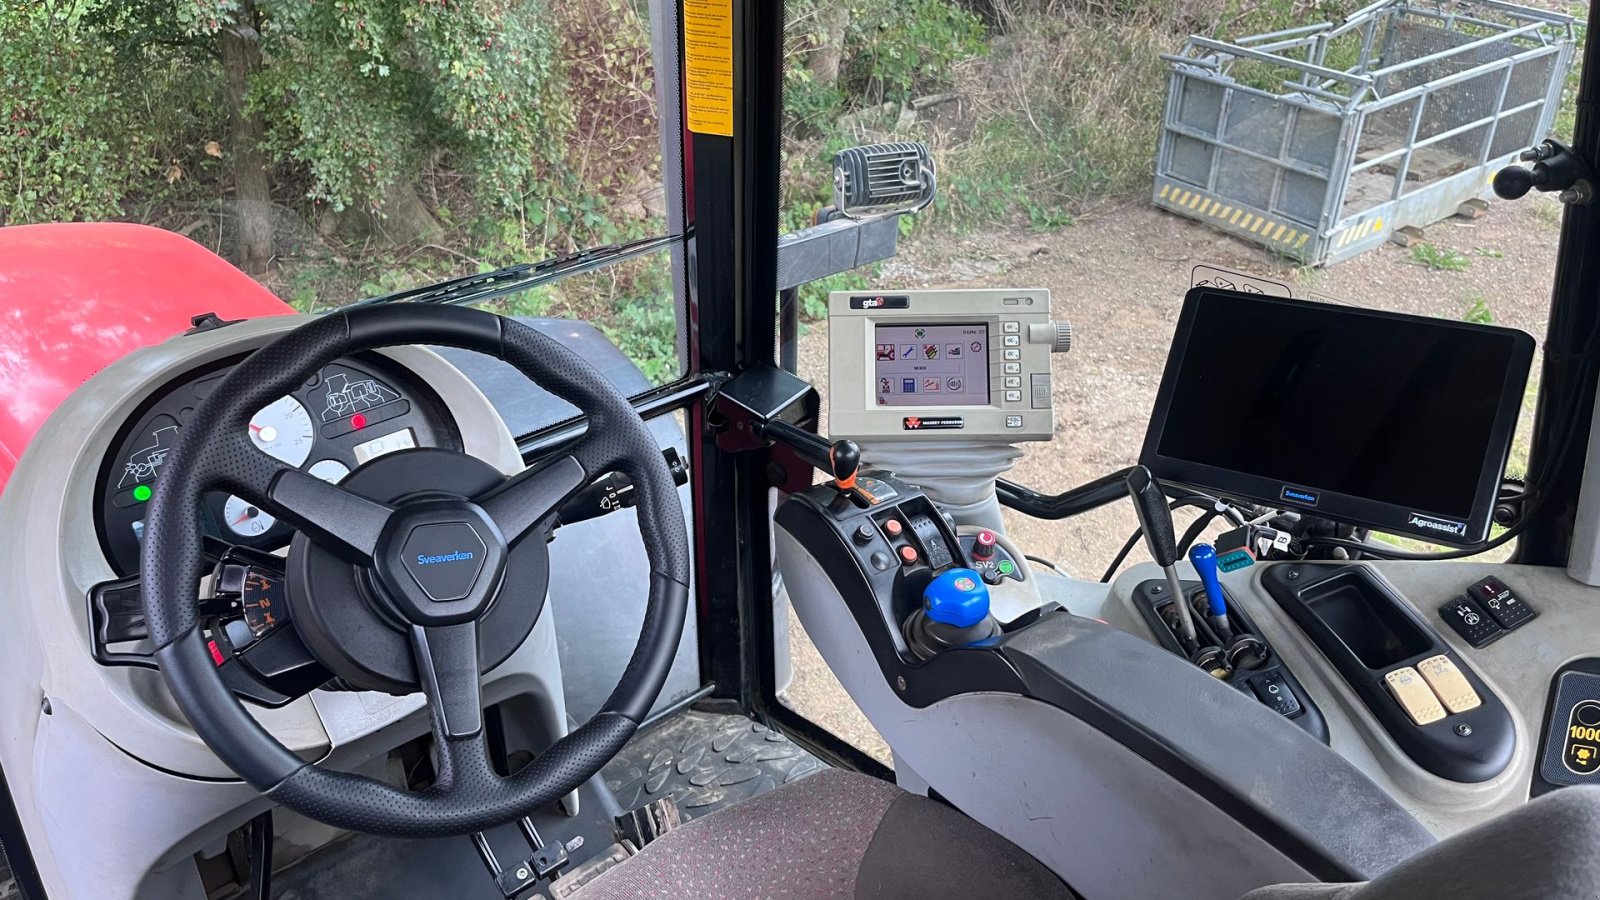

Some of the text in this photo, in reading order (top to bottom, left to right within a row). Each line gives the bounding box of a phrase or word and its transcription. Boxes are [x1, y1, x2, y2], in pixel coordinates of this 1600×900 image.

[1410, 516, 1459, 534] Agroassist
[417, 550, 474, 565] Sveaverken
[975, 560, 995, 569] SV2
